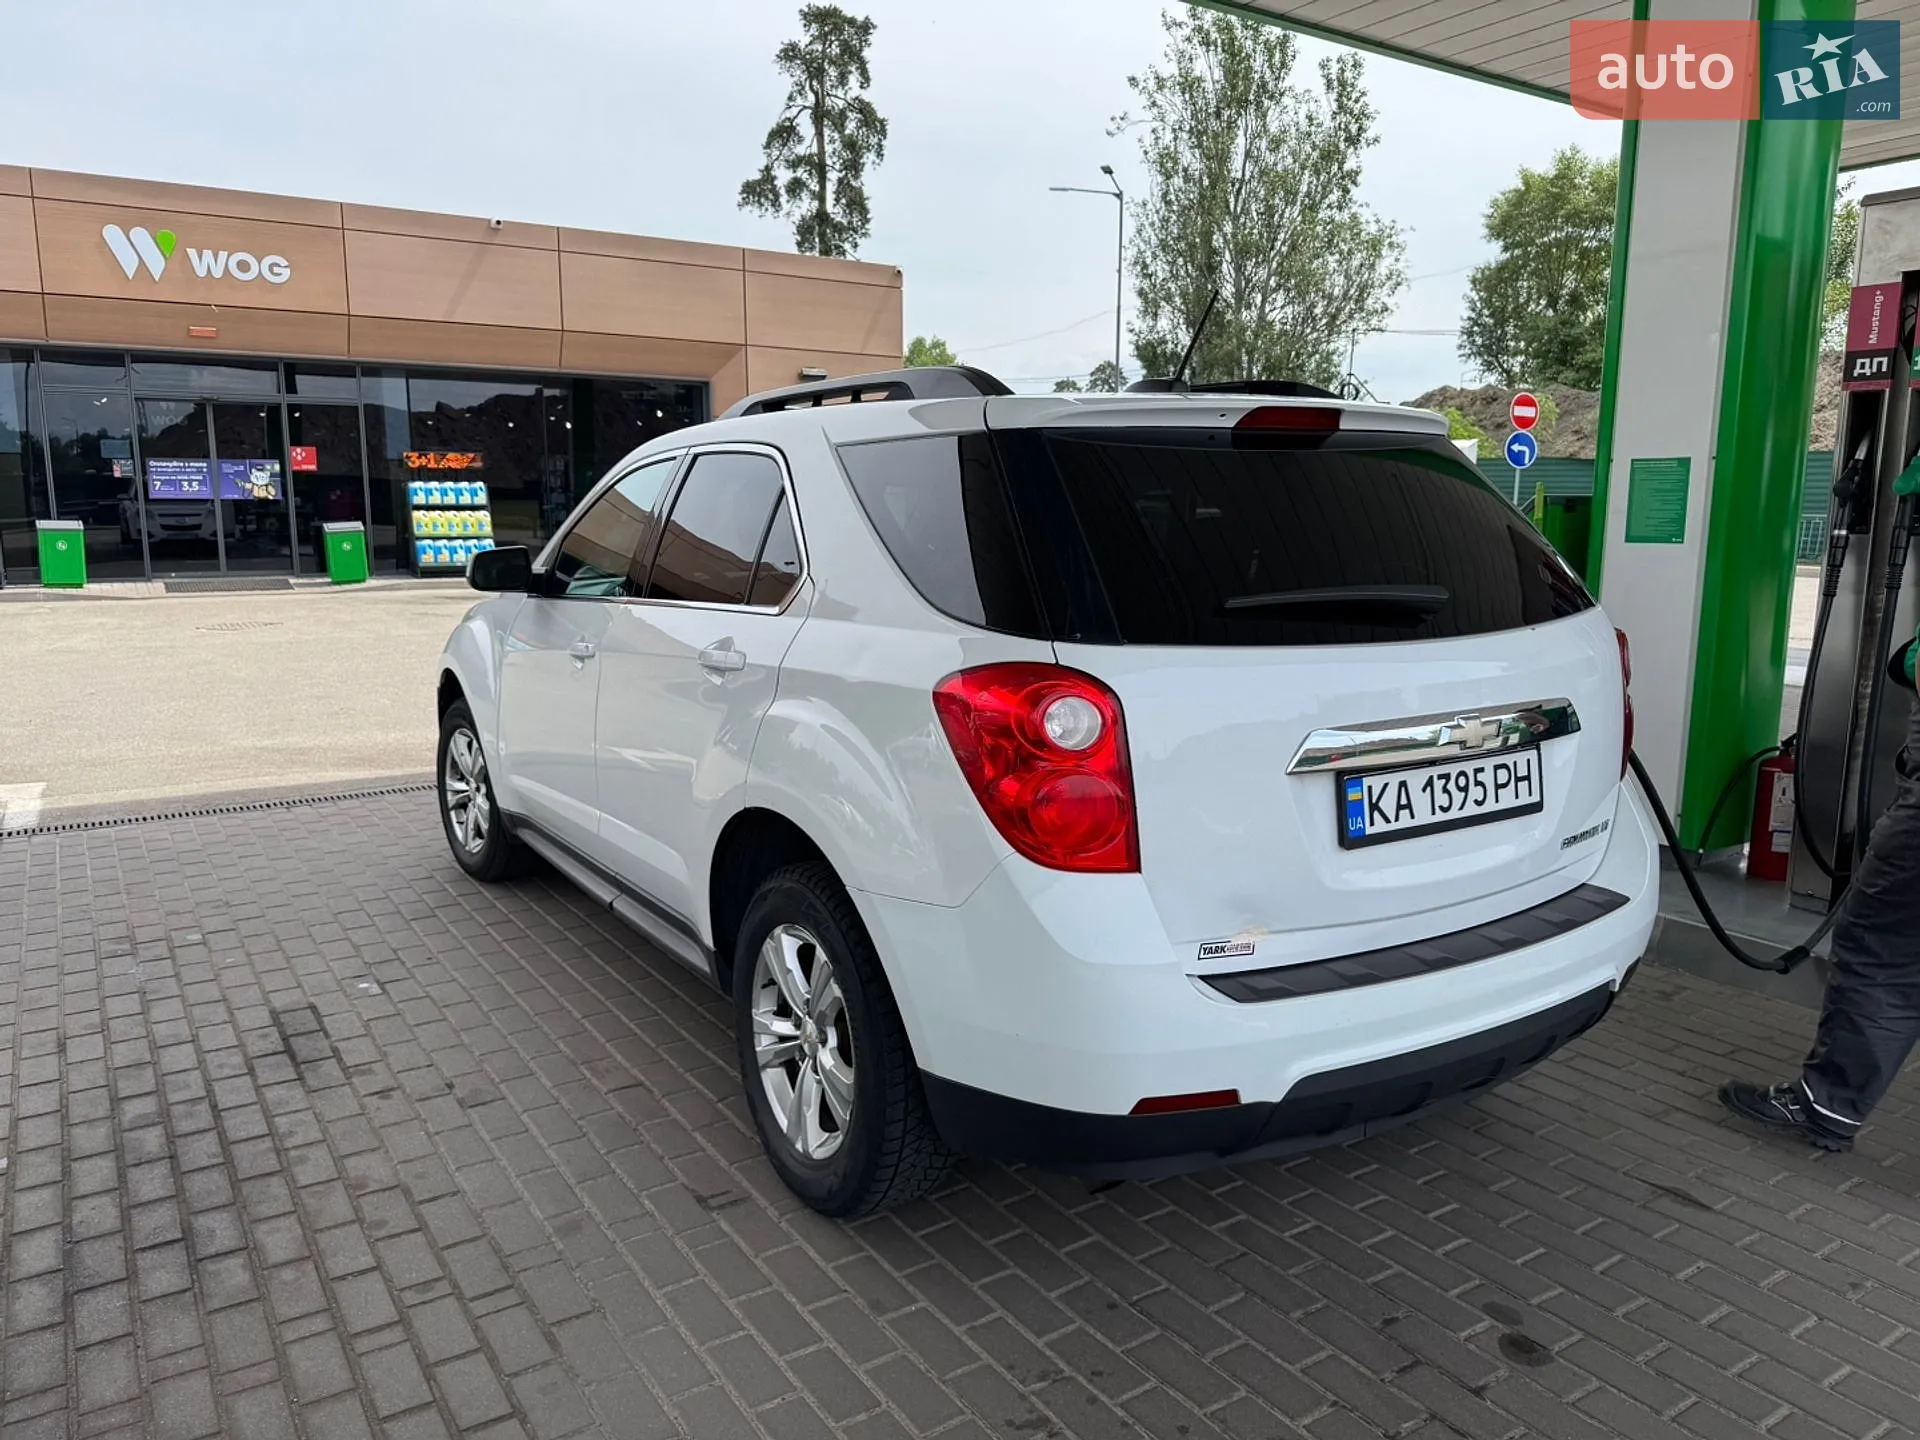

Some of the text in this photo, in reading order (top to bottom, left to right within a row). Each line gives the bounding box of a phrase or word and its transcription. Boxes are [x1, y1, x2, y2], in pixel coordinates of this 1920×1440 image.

[186, 248, 291, 284] WOG
[1853, 356, 1888, 377] ДП
[153, 481, 161, 491] 7
[181, 481, 199, 492] 3,5
[1367, 758, 1533, 827] KA 1395 PH
[1349, 818, 1364, 831] UA
[1202, 944, 1228, 956] YARK
